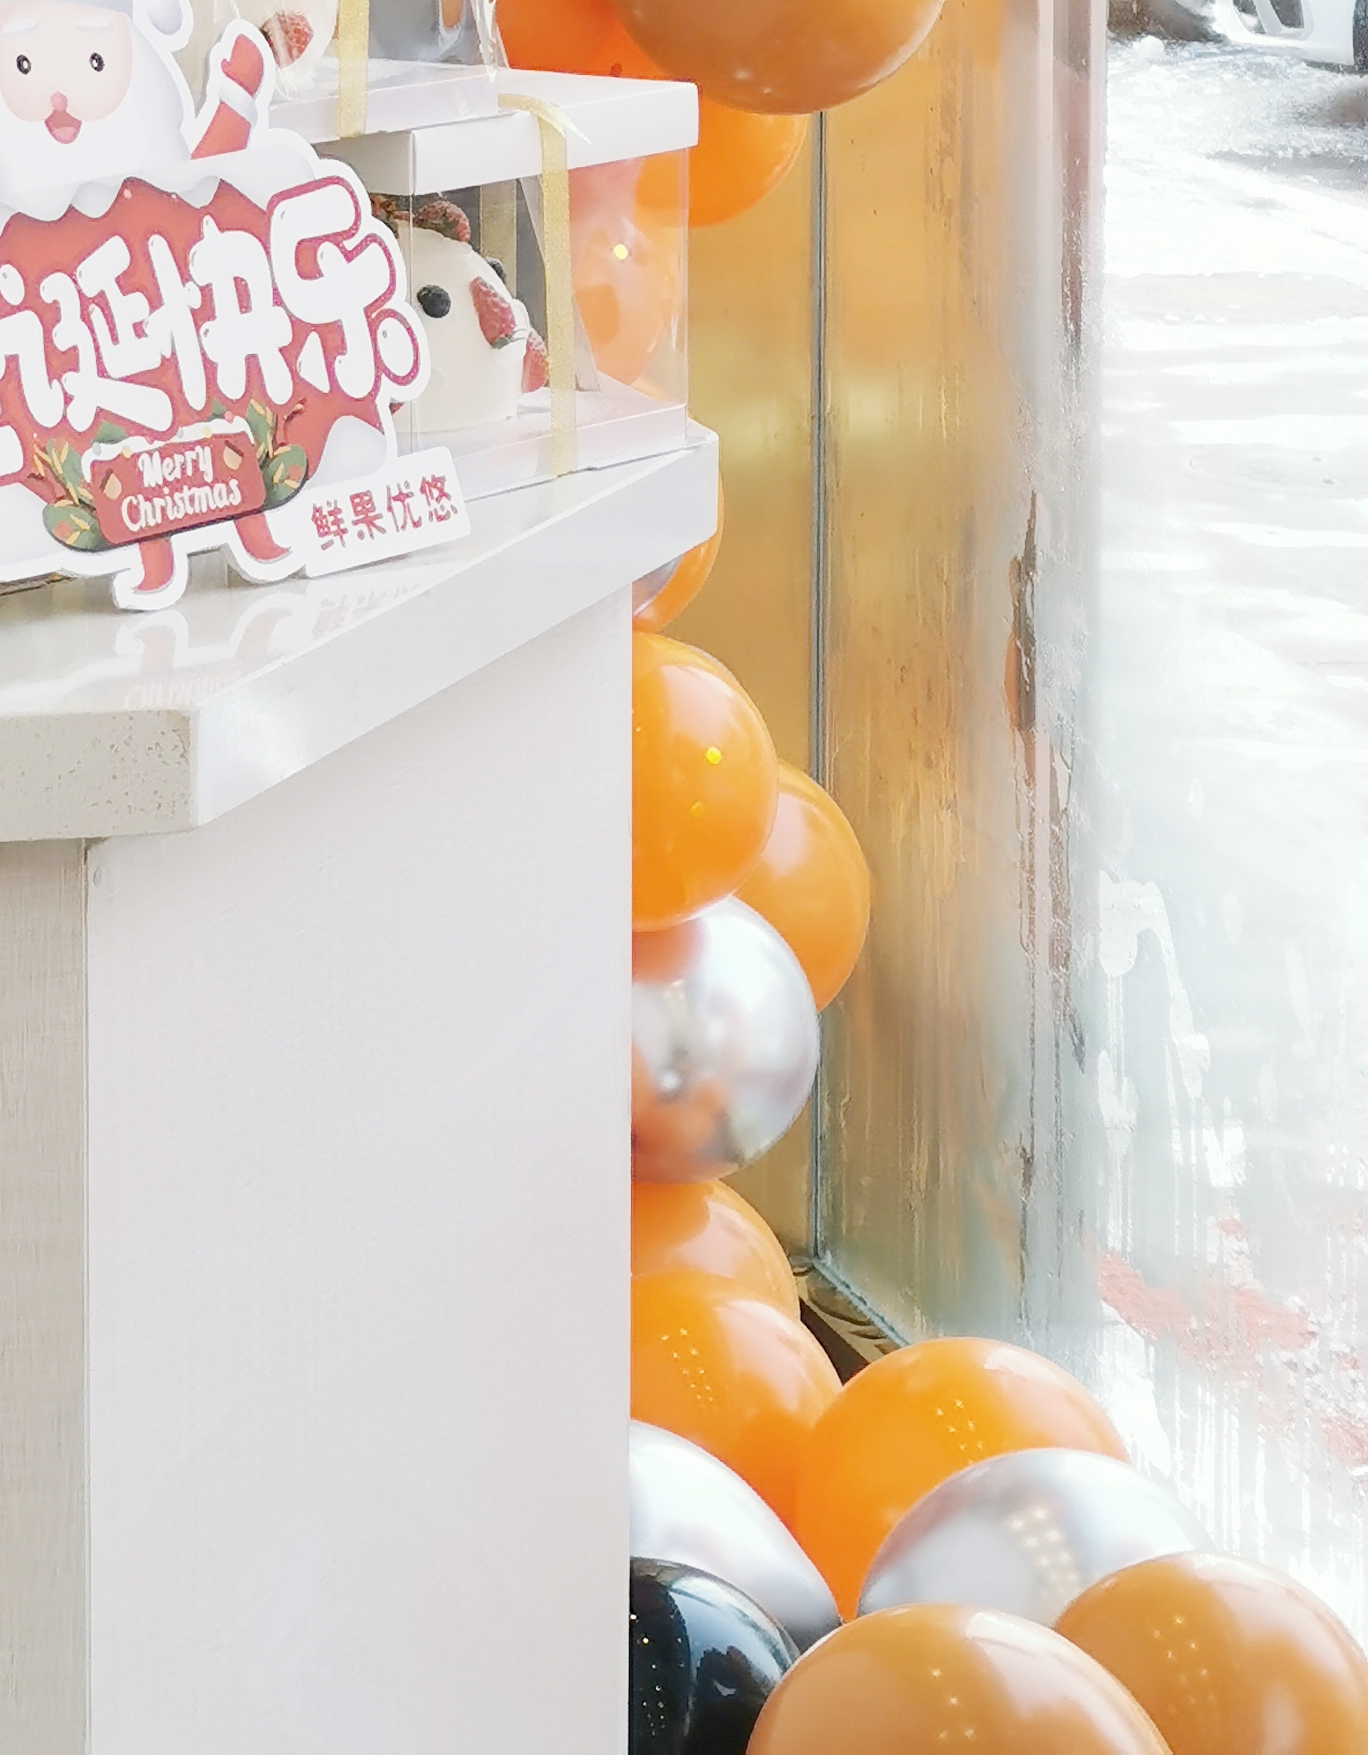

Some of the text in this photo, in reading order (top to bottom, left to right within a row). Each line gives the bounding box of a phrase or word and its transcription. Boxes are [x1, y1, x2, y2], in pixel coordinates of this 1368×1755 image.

[137, 445, 213, 487] Merry
[121, 479, 242, 532] Christmas
[311, 474, 458, 551] 鲜果优悠
